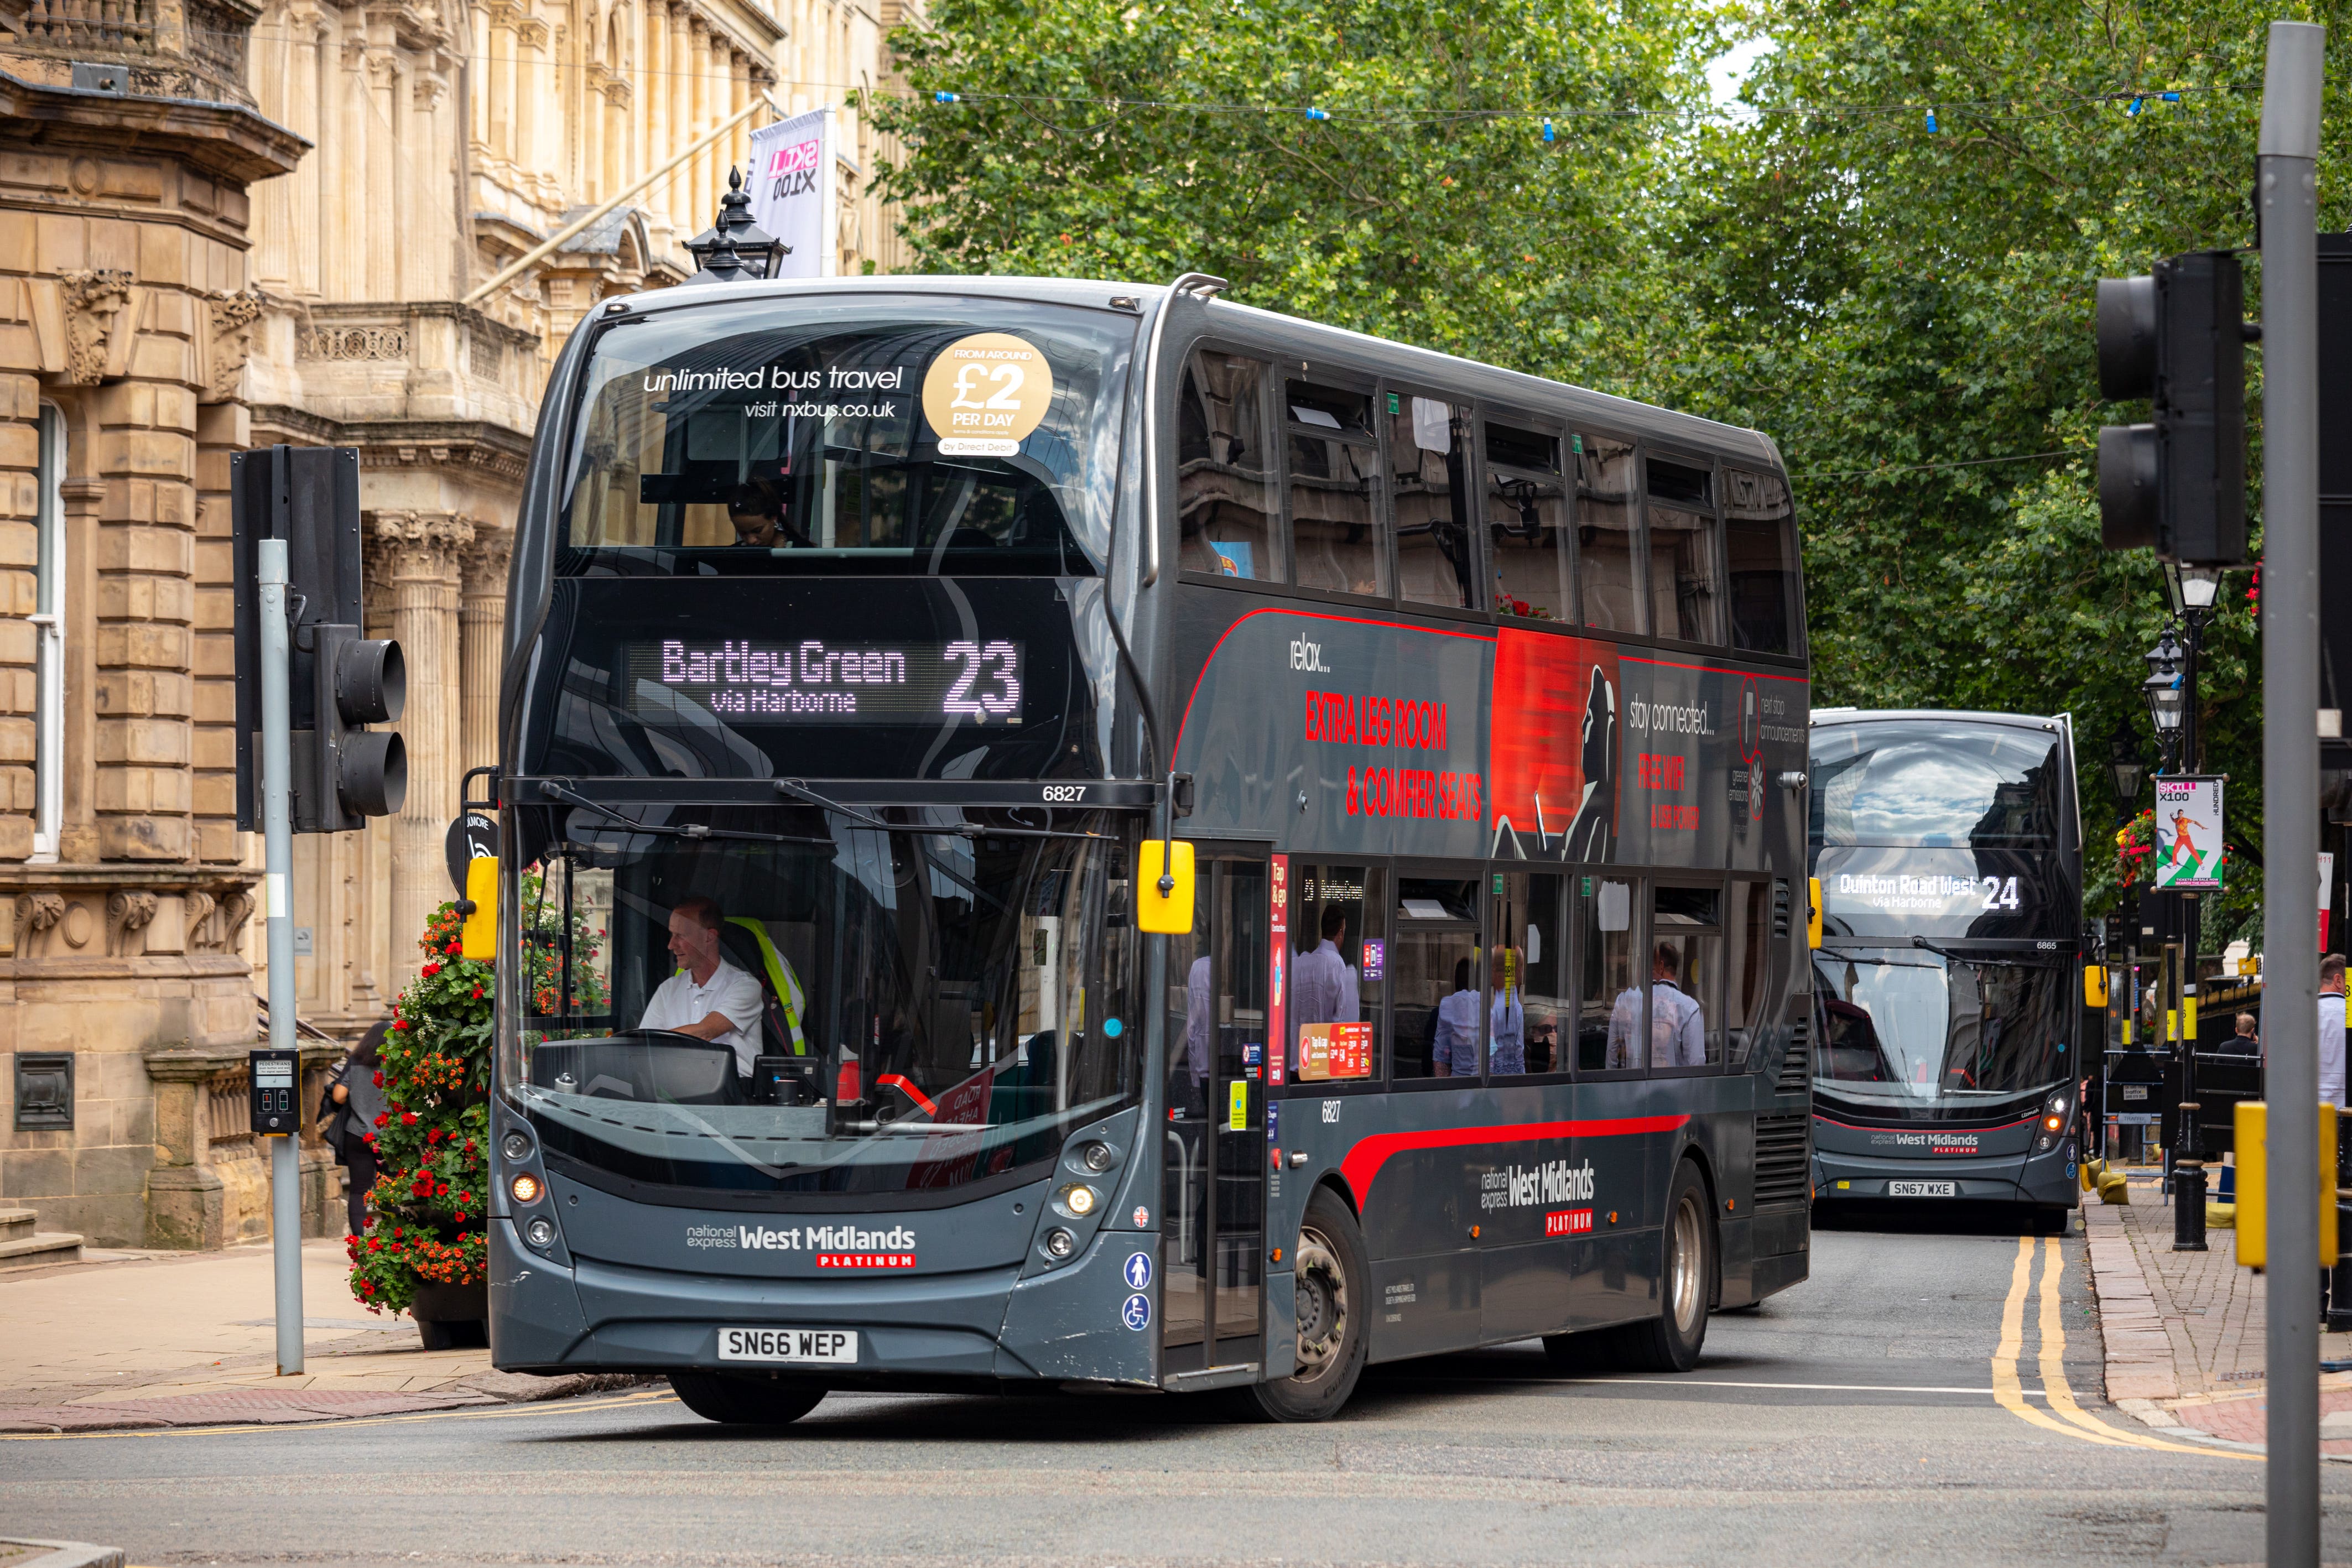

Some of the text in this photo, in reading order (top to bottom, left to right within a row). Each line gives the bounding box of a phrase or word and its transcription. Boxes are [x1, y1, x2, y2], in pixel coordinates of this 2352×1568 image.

[954, 350, 1033, 360] FROM AROUND
[643, 366, 903, 392] unlimited bus travel
[950, 363, 1024, 410] £2
[745, 401, 895, 417] visit nxbus.co.uk
[953, 413, 1015, 426] PER DAY
[944, 442, 1012, 451] by Direct Debit
[1291, 632, 1330, 673] relax...
[663, 642, 1019, 712] Bartley Green 23
[711, 690, 856, 711] via Harborne
[1761, 698, 1784, 716] next stop
[1306, 690, 1446, 750] EXTRA LEG ROOM
[1630, 693, 1714, 738] stay connected...
[1761, 724, 1805, 743] announcements
[1638, 753, 1684, 790] FREE WIFI
[1732, 770, 1749, 785] greener
[1043, 786, 1086, 801] 6827
[1346, 765, 1481, 822] & COMFIER SEATS
[1729, 786, 1748, 802] emissions
[2160, 783, 2196, 793] SKILL
[2160, 793, 2189, 801] X100
[1651, 804, 1699, 830] & USB POWER
[1273, 863, 1284, 885] Tap
[1278, 889, 1286, 908] go
[1840, 874, 2019, 909] Quinton Road West 24
[1872, 897, 1941, 908] via Harborne
[1322, 1101, 1341, 1123] 6827
[2021, 1108, 2039, 1118] Uzmah
[1897, 1134, 1978, 1145] West Midlands
[1481, 1166, 1508, 1190] national
[1509, 1159, 1594, 1206] West Midlands
[1895, 1184, 1950, 1195] SN67 WXE
[1481, 1190, 1507, 1214] express
[686, 1225, 736, 1237] national
[1547, 1212, 1591, 1233] PLATINUM
[687, 1237, 736, 1250] express
[739, 1226, 915, 1249] West Midlands
[821, 1256, 912, 1266] PLATINUM
[729, 1331, 845, 1356] SN66 WEP
